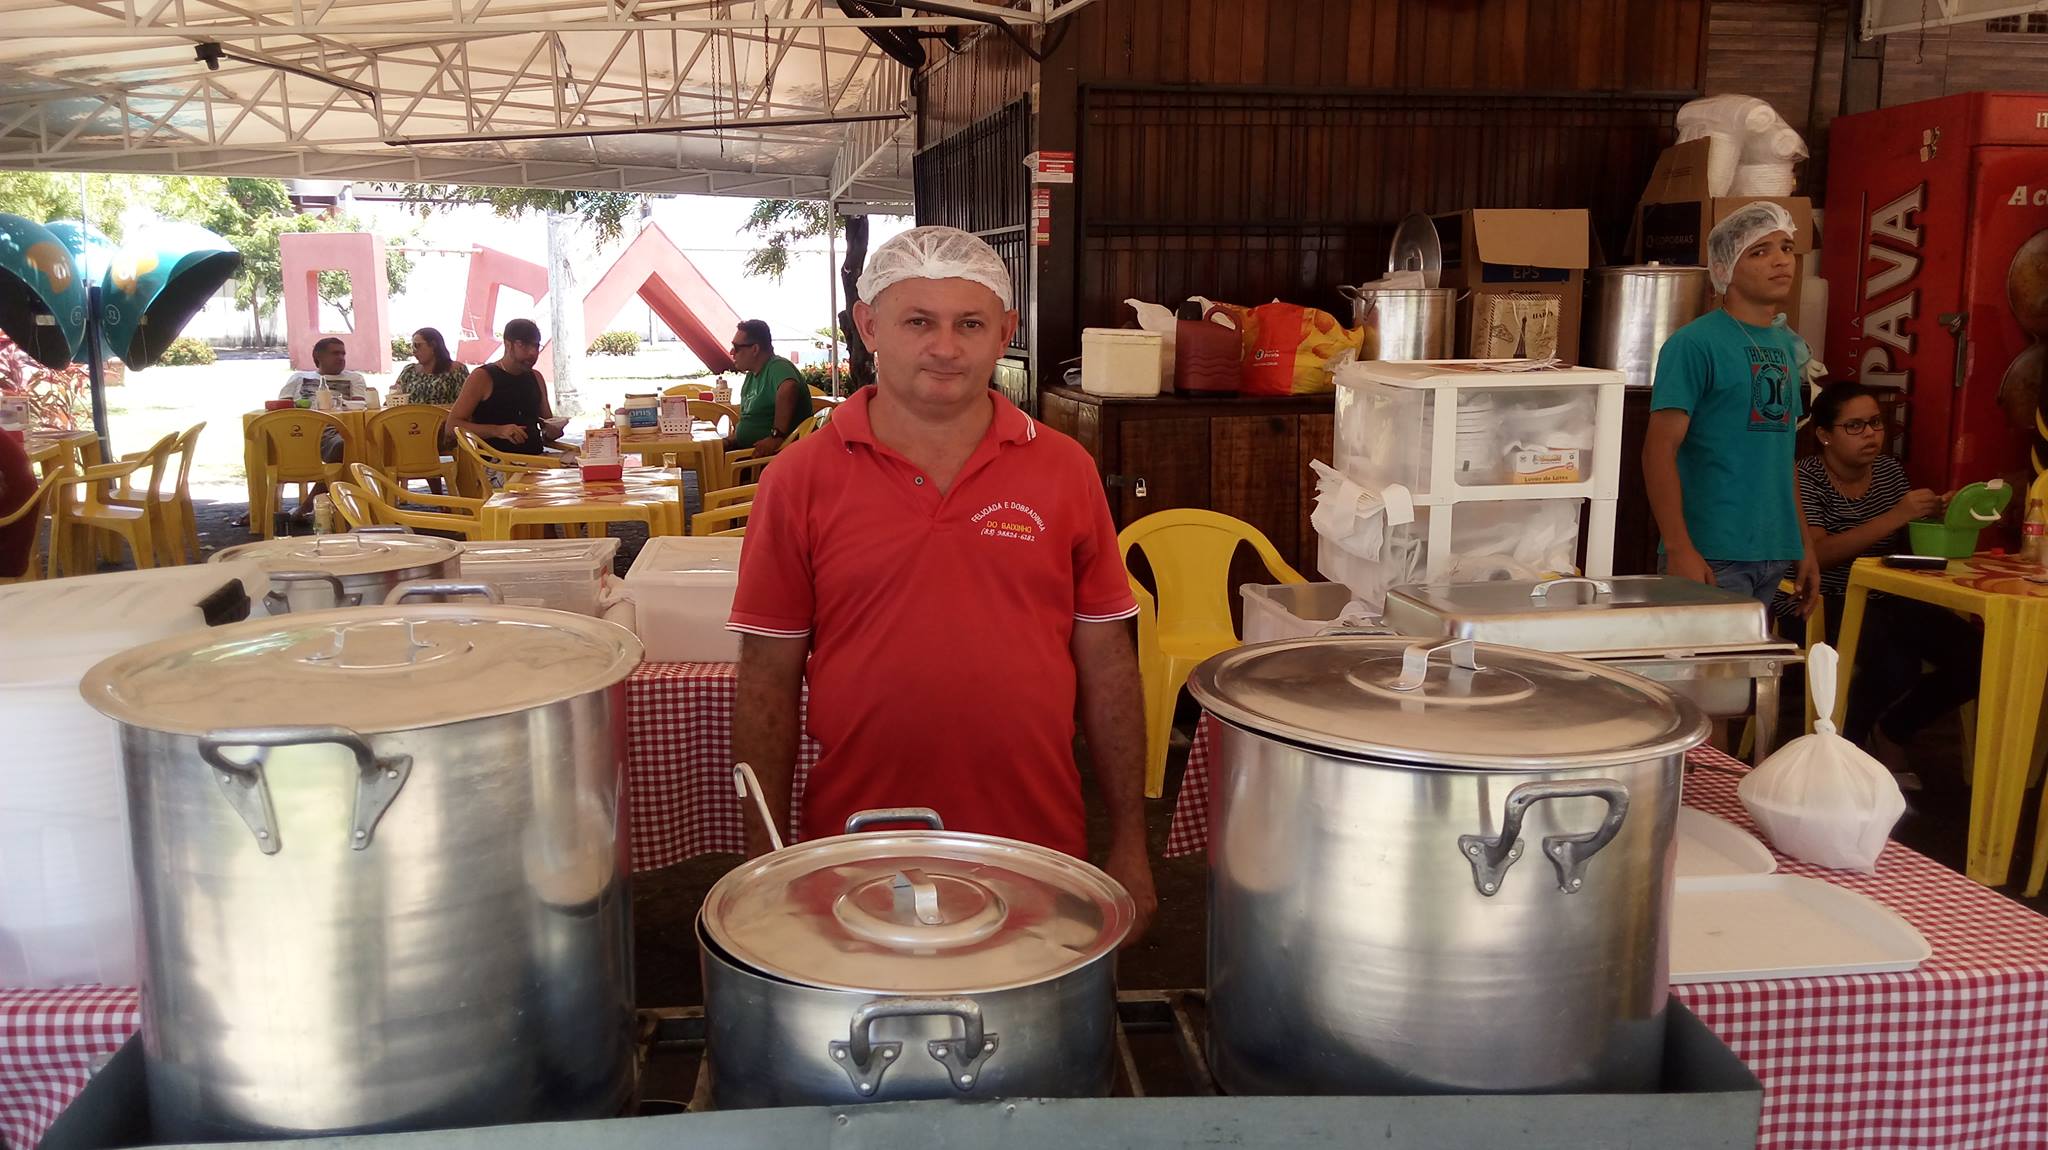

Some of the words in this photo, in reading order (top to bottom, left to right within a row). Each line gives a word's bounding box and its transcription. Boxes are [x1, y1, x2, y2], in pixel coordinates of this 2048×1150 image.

[2008, 185, 2027, 206] A
[1512, 267, 1540, 279] EPS
[1859, 182, 1927, 458] PAVA
[971, 502, 1003, 523] FEIJOADA
[1004, 501, 1009, 509] E
[1010, 502, 1046, 532] DOBRADINHA
[986, 520, 997, 529] DO
[1001, 522, 1032, 534] BAIXINHO
